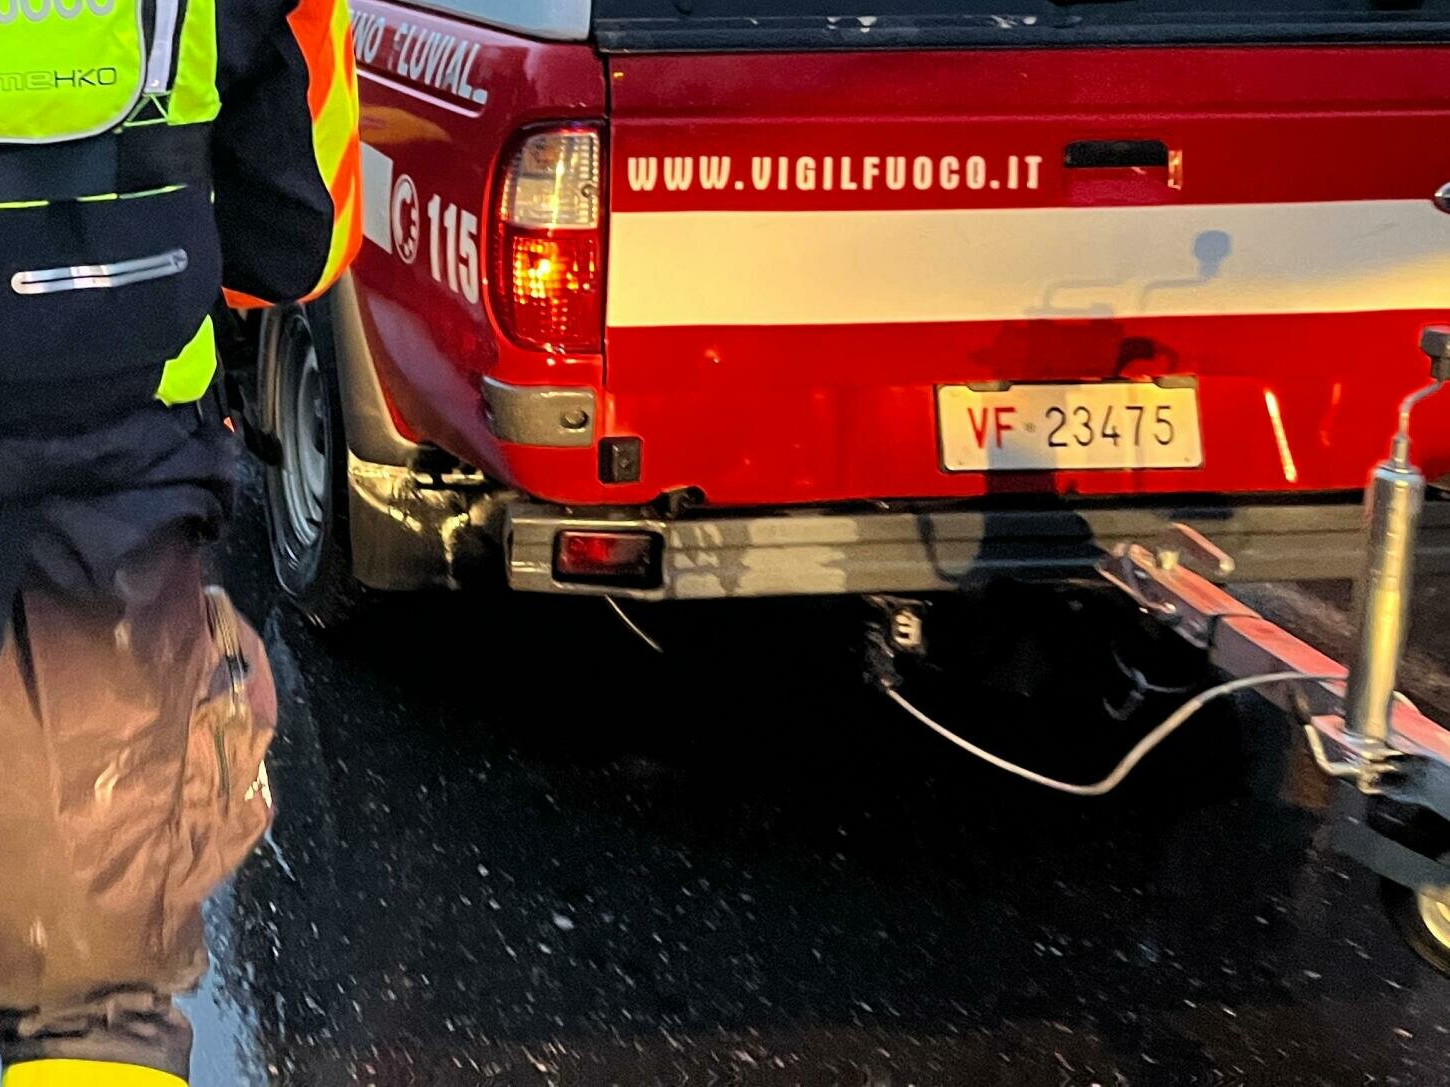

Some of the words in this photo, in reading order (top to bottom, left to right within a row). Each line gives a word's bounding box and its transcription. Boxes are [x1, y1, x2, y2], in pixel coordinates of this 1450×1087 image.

[627, 154, 1043, 192] WWW.VIGILFUOCO.IT
[427, 193, 479, 305] 115
[967, 406, 1017, 450] VF
[1045, 404, 1175, 448] 23475
